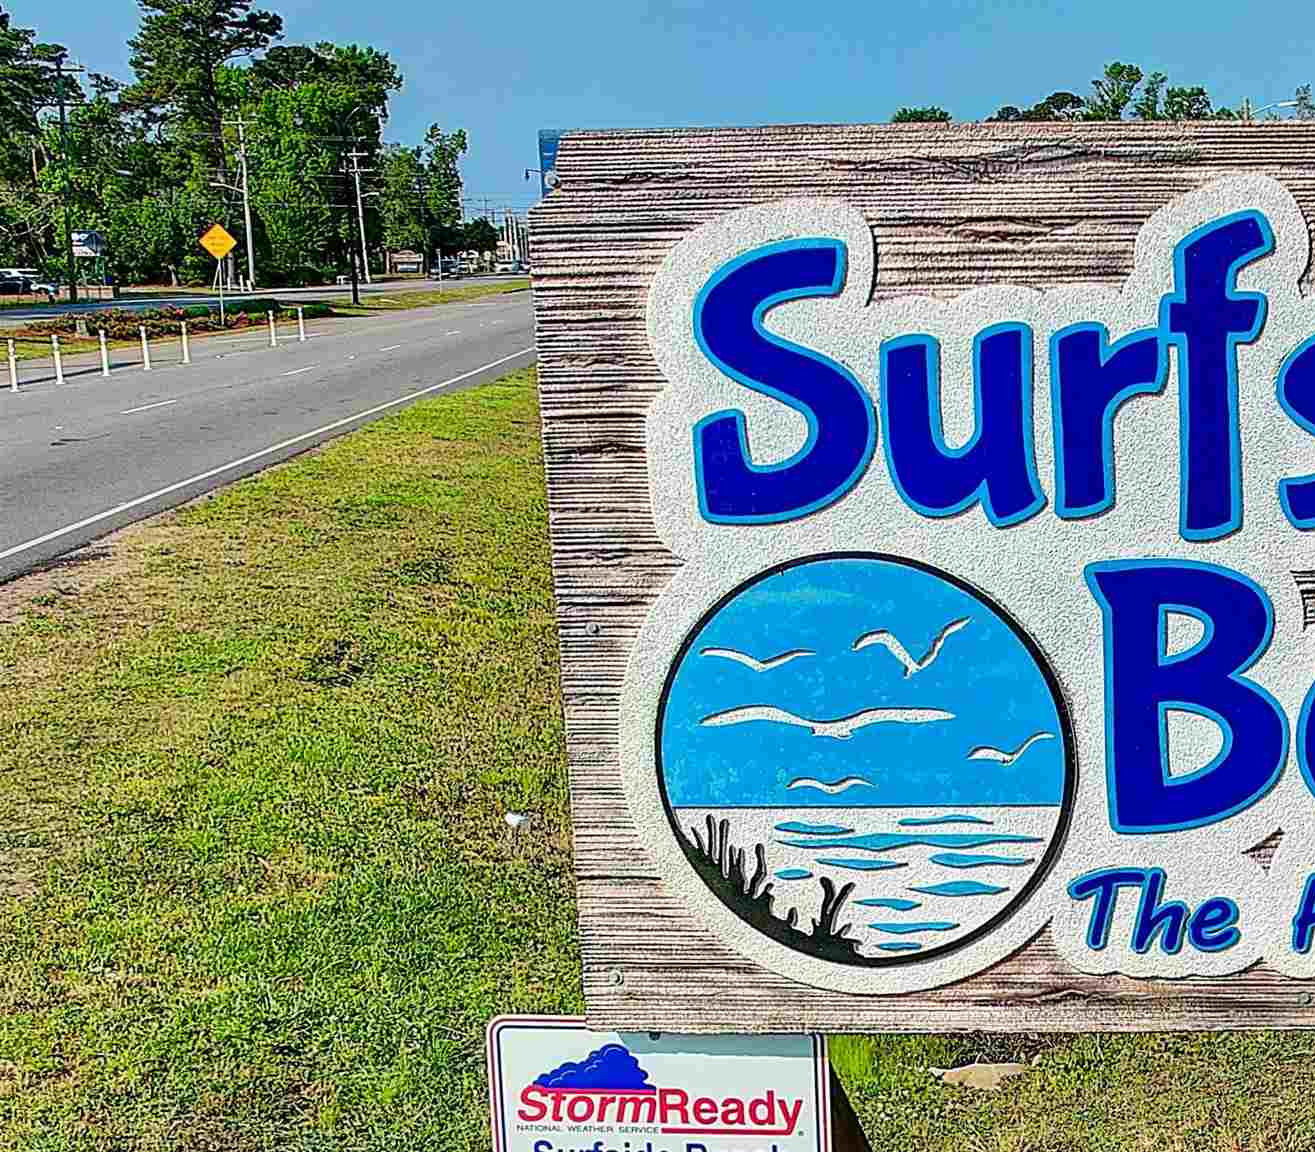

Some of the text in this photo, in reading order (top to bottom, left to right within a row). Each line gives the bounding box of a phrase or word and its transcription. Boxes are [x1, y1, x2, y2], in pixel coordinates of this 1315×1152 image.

[1067, 867, 1241, 954] The
[516, 1124, 659, 1134] NATIONAL WEATHER SERVICE
[517, 1085, 803, 1136] StormReady
